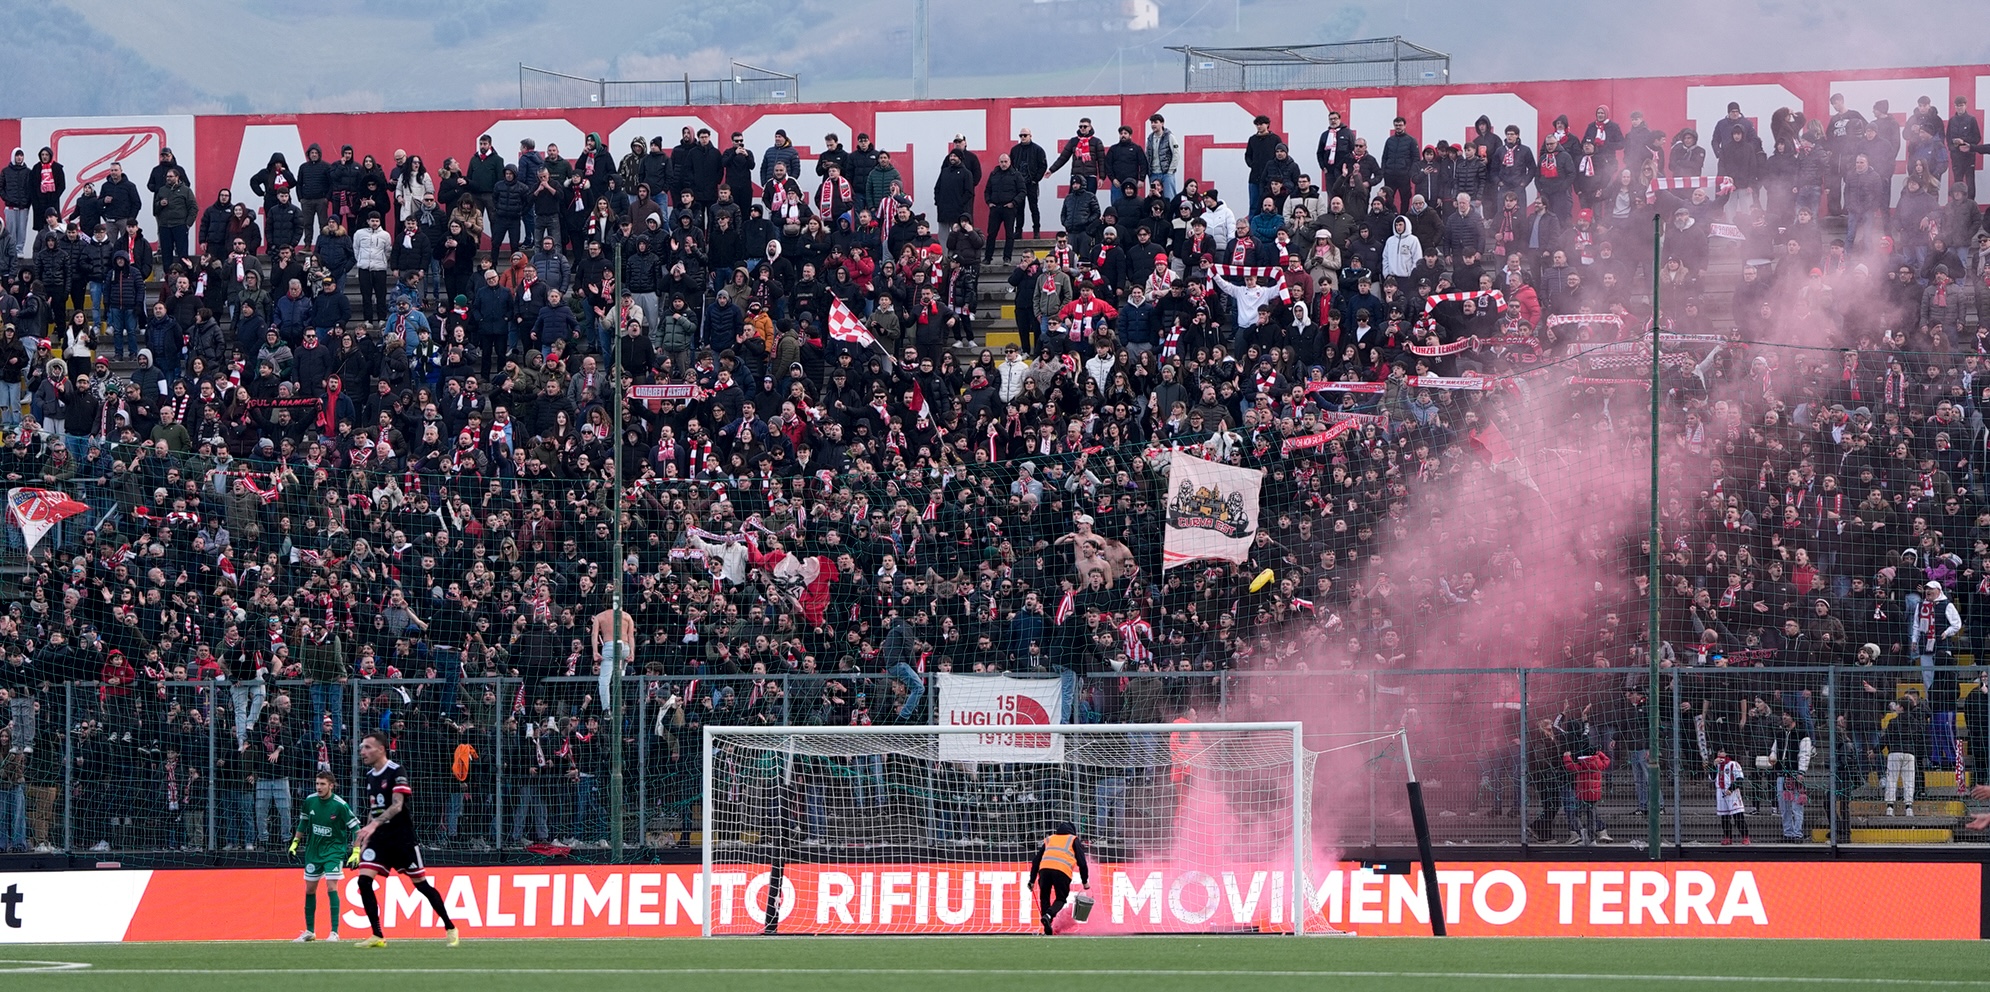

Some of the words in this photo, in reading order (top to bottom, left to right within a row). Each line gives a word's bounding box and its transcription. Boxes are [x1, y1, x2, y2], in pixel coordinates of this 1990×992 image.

[1687, 75, 1990, 210] DE
[1411, 344, 1436, 355] FORZA
[1178, 517, 1213, 527] CURVA
[1215, 521, 1236, 535] EST
[997, 694, 1015, 711] 15
[951, 710, 1015, 725] LUGLIO
[342, 872, 790, 928] SMALTIMENTO
[816, 871, 1032, 924] RIFIUTI
[1111, 869, 1527, 925] MOVIMENTO
[1546, 870, 1768, 925] TERRA
